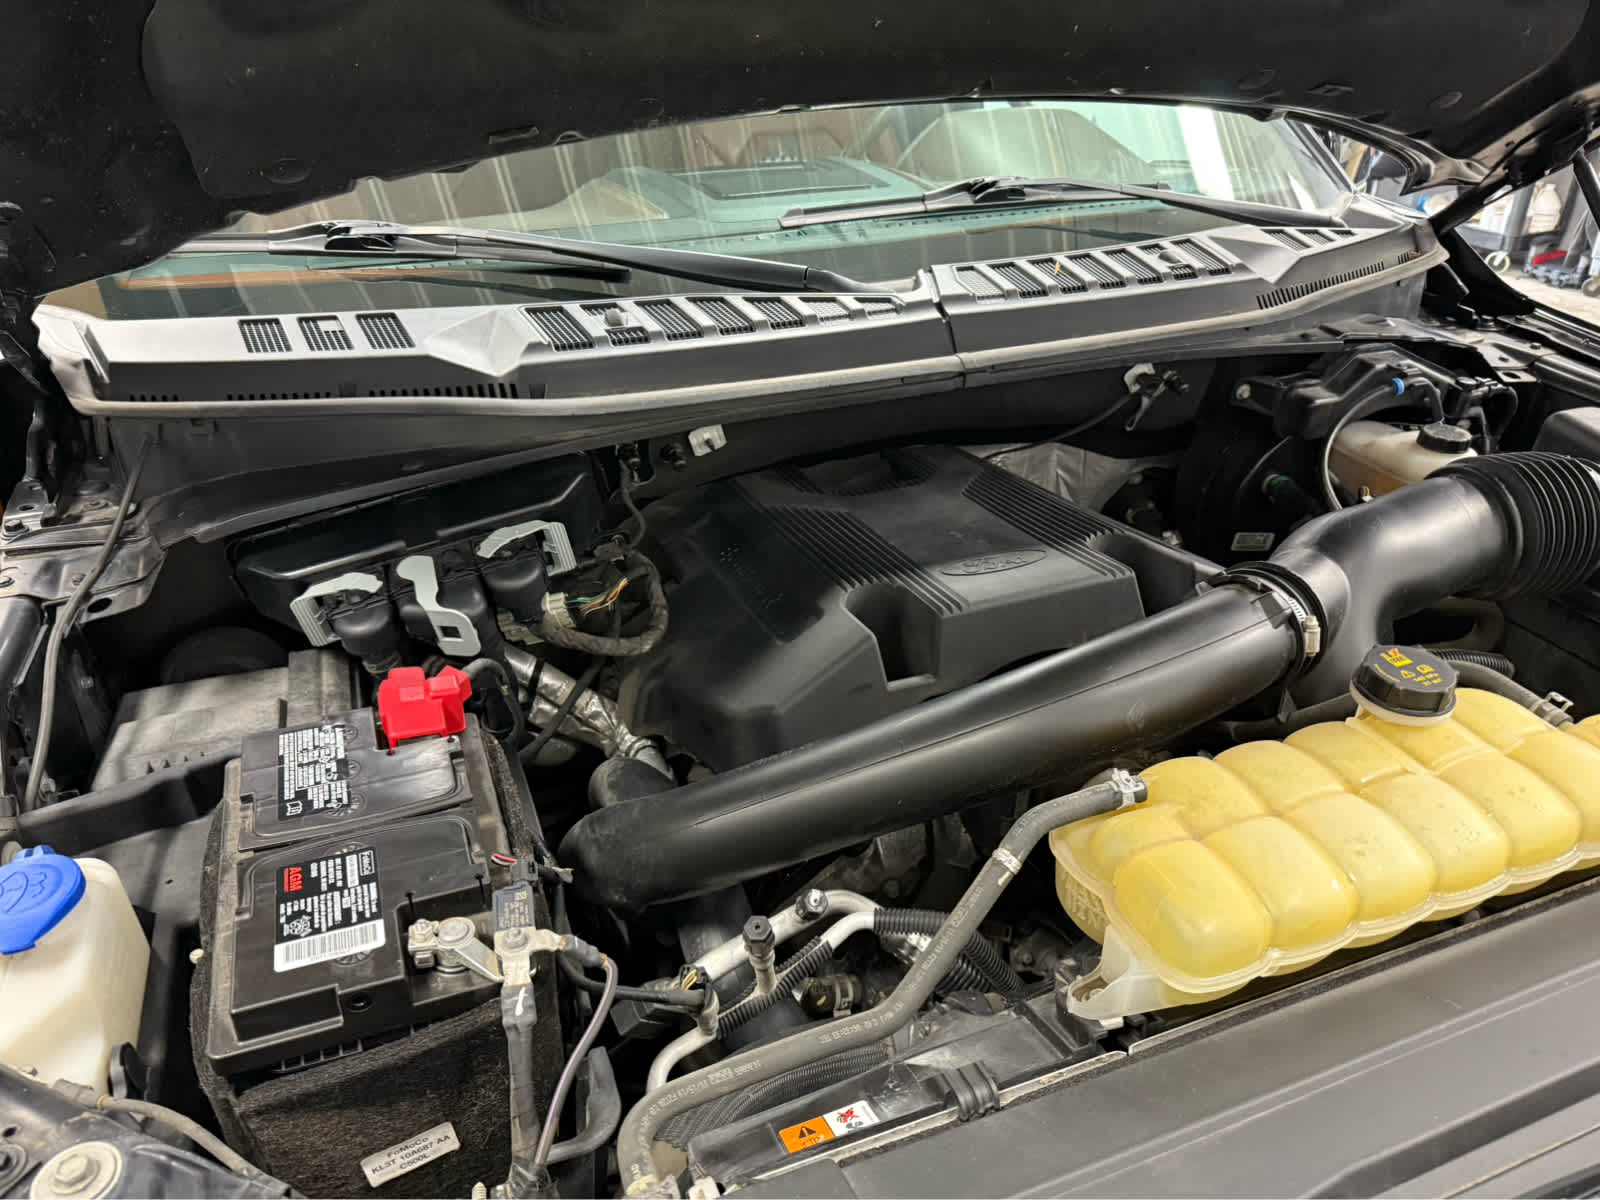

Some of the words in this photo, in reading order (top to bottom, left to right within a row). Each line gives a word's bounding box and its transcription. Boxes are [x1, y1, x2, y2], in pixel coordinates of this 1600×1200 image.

[289, 867, 303, 892] AGM
[371, 1159, 396, 1174] KL3T
[437, 1135, 451, 1144] AA
[387, 1137, 429, 1158] FoMoCo
